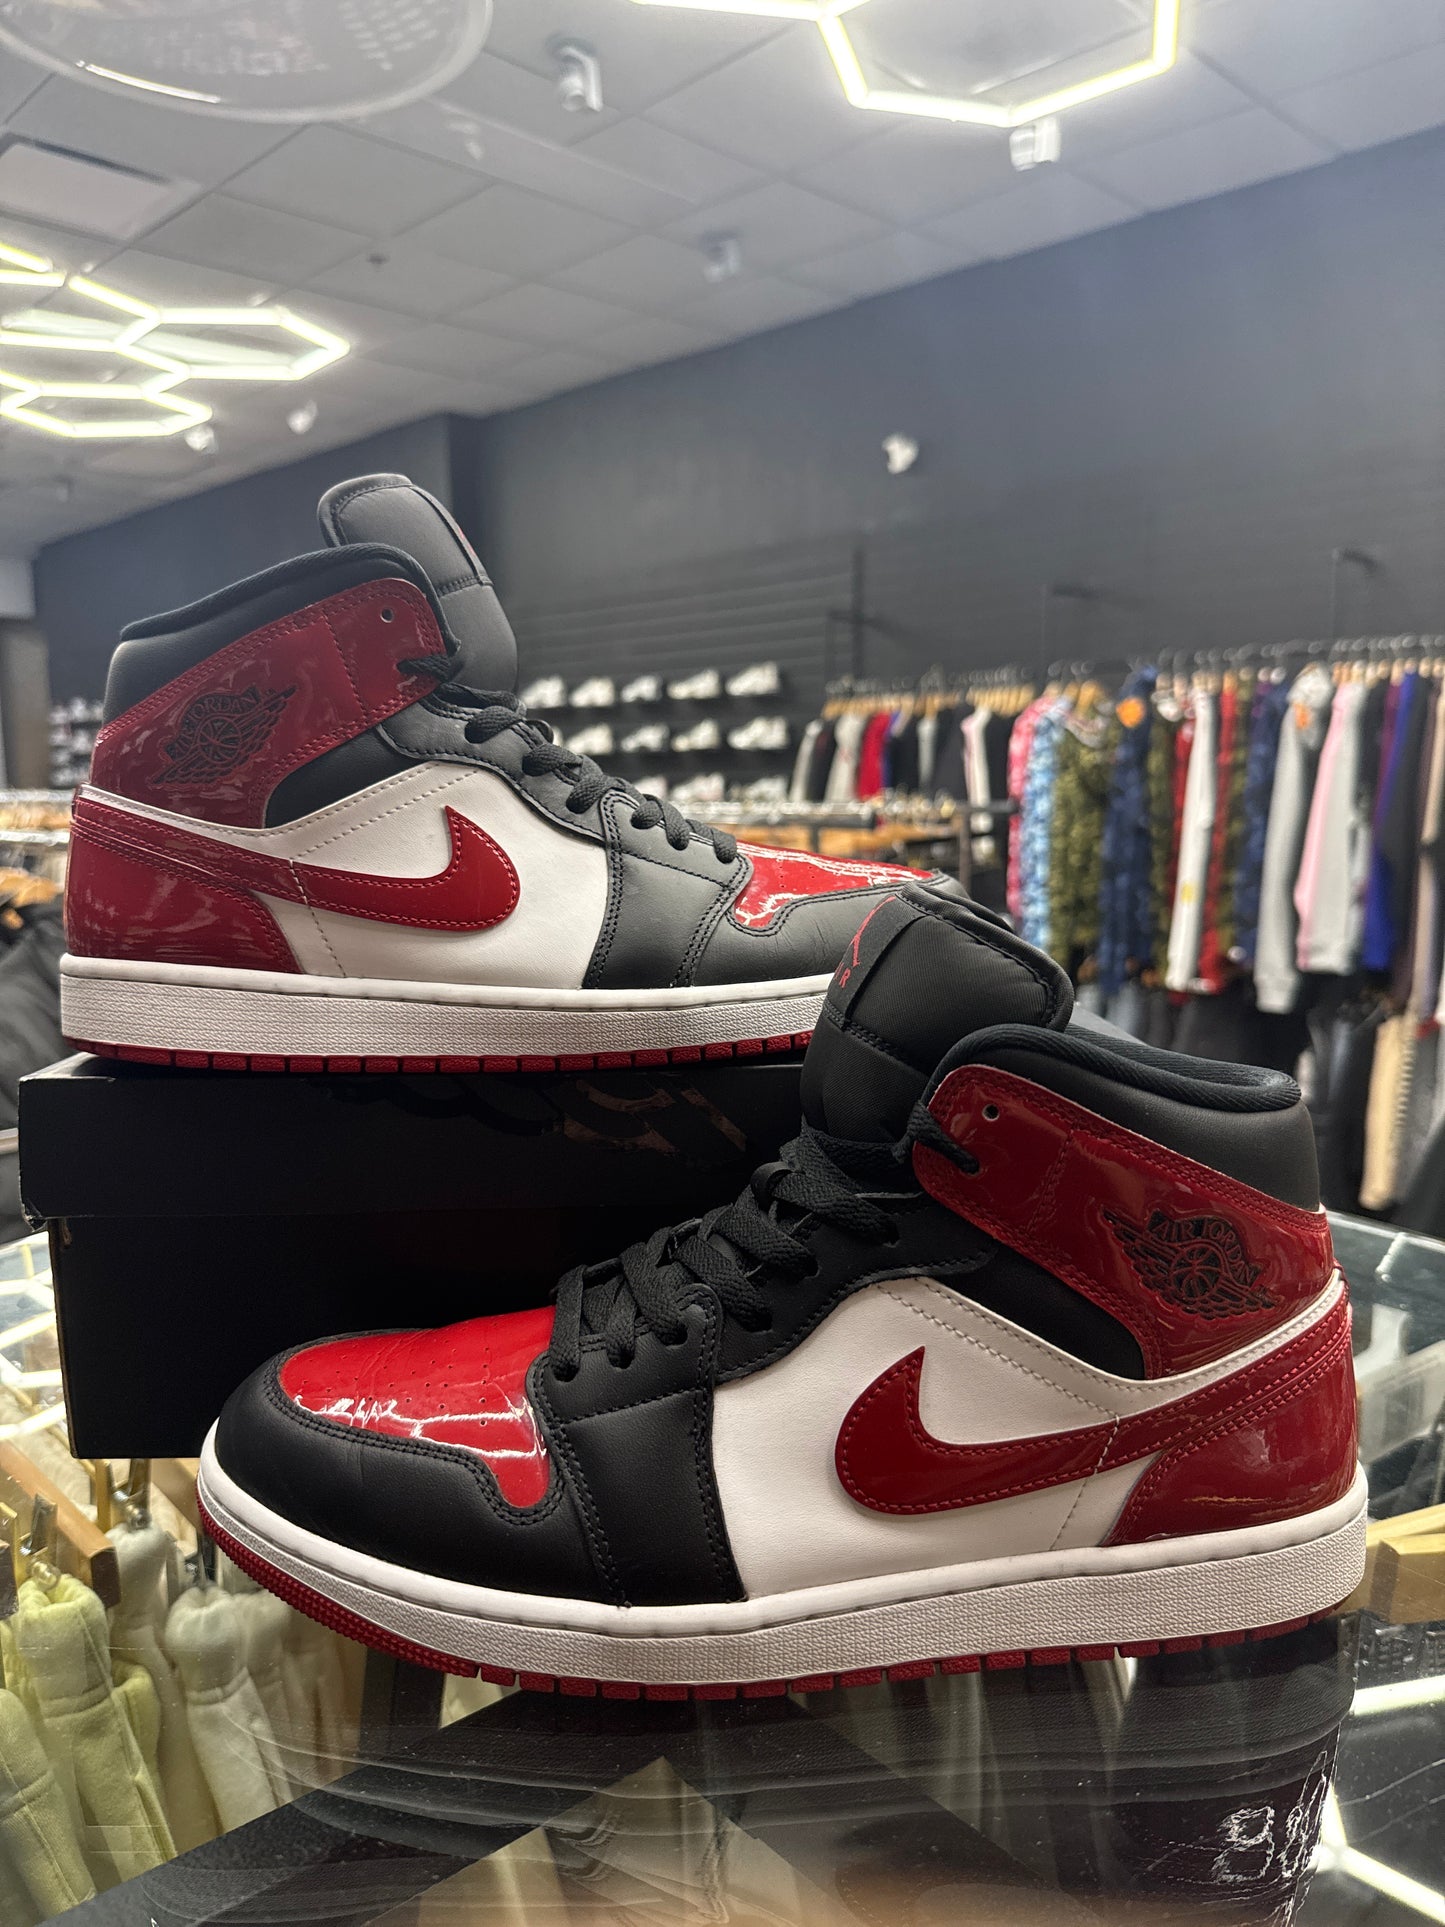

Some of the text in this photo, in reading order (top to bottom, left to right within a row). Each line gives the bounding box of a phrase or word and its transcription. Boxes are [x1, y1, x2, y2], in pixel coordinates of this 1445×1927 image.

[186, 692, 258, 721] JORDAN
[1152, 1219, 1252, 1285] AIR JORDAN
